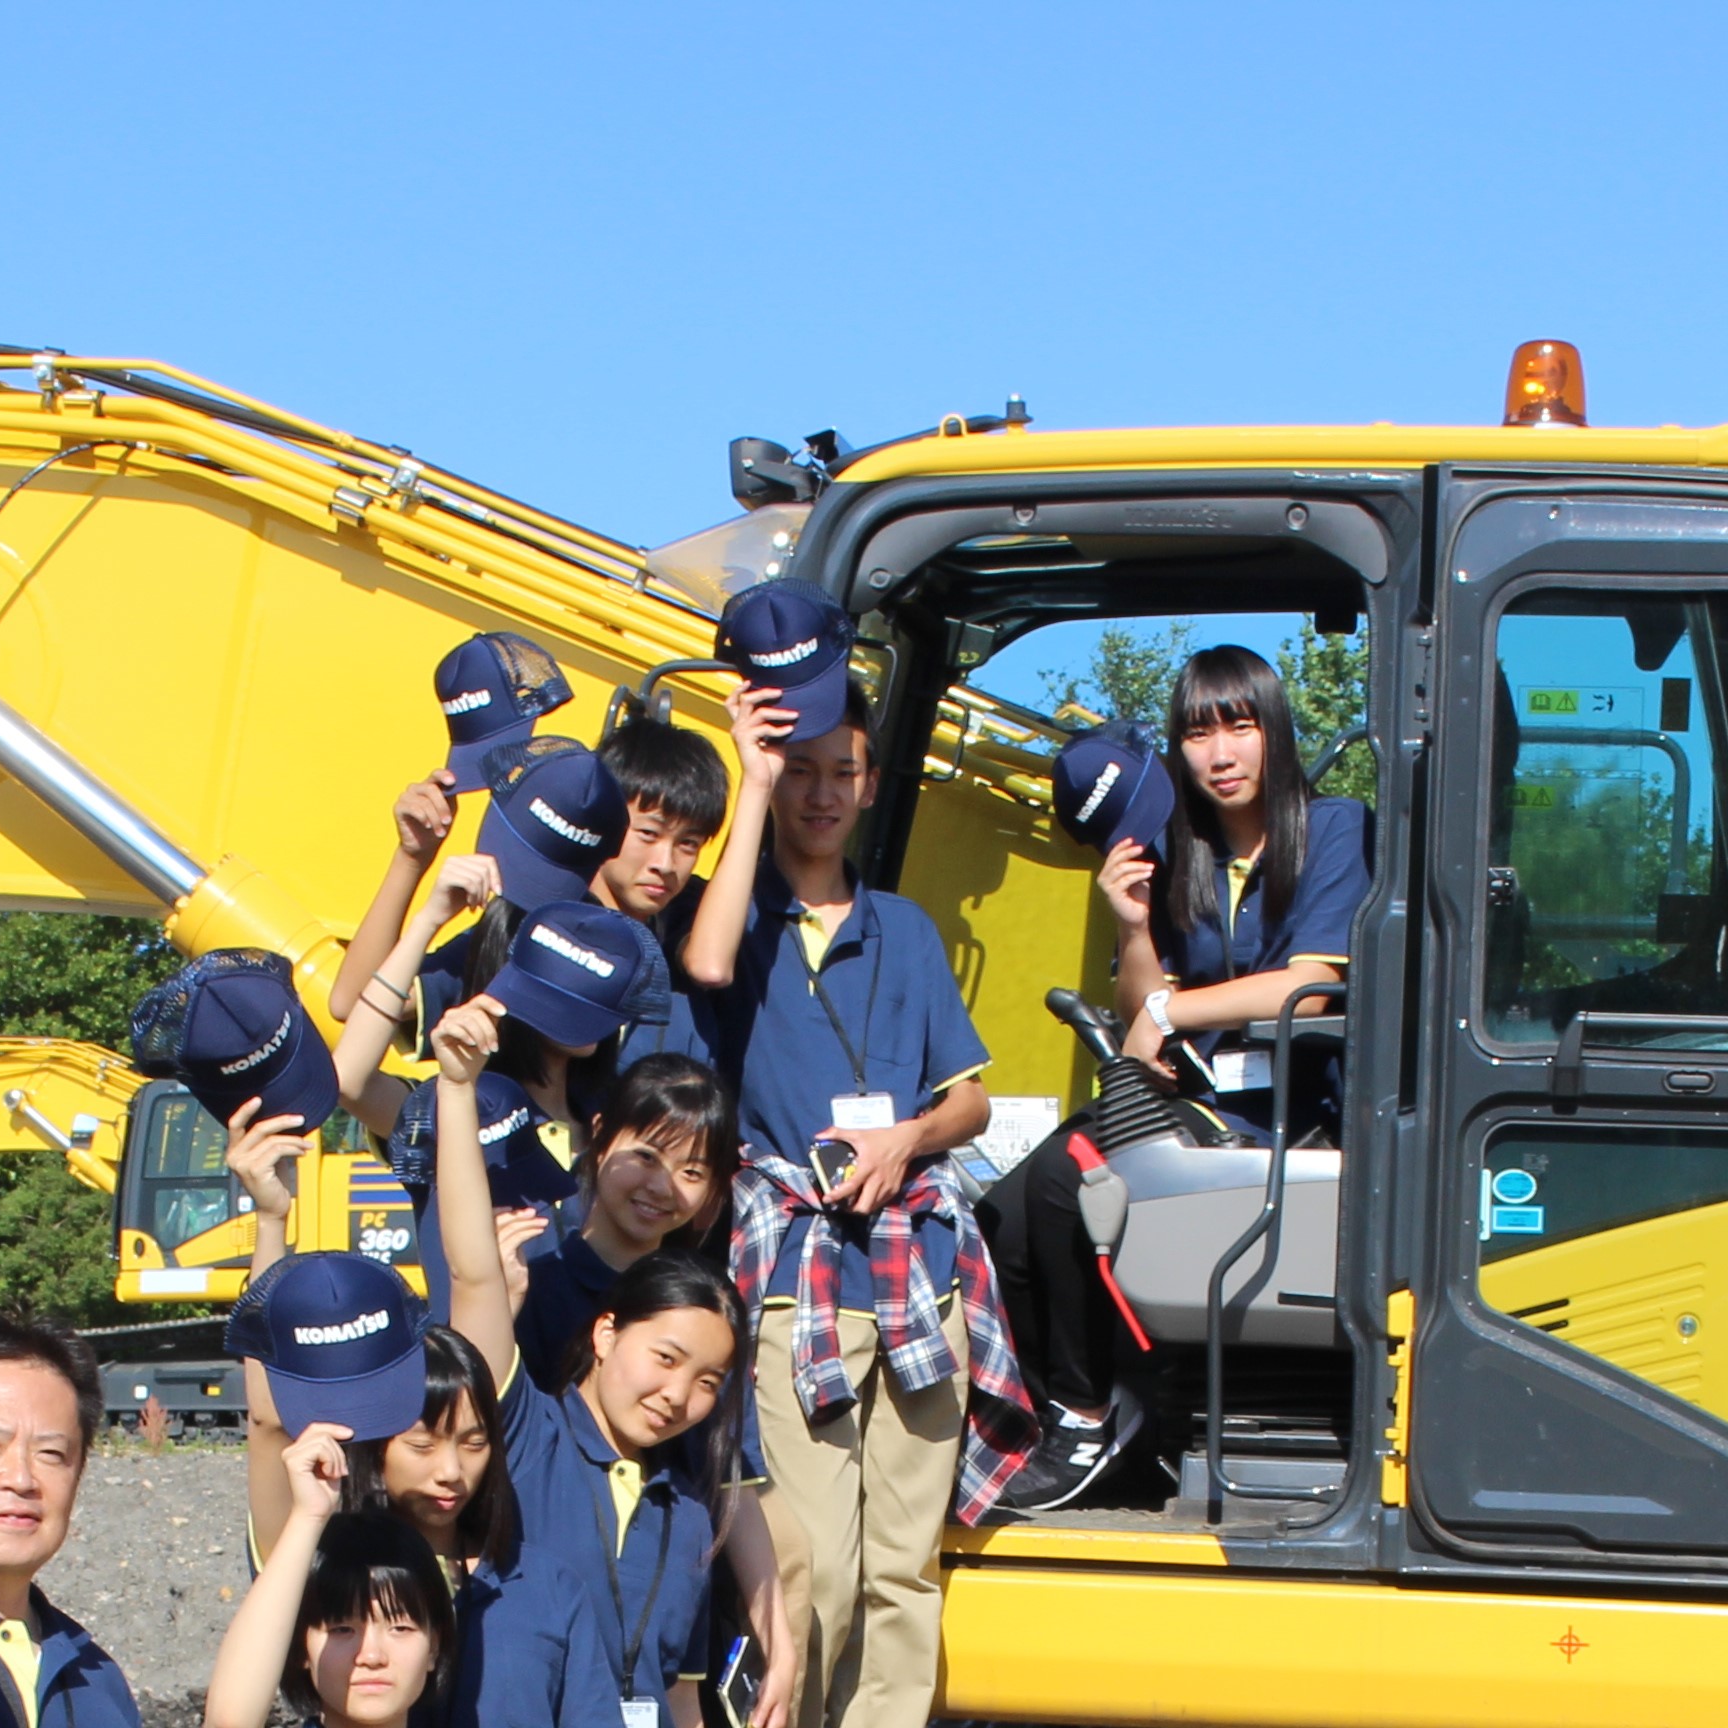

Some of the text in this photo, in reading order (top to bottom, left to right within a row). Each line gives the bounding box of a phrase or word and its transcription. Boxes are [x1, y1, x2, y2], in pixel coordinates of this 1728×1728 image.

[749, 637, 818, 667] KOMATSU
[442, 688, 492, 715] MATSU
[1075, 762, 1122, 823] KOMATSU
[529, 797, 603, 847] KOMATSU
[530, 923, 616, 978] KOMATSU
[220, 1010, 292, 1075] KOMATSU
[477, 1106, 530, 1145] OMATSU
[359, 1211, 387, 1228] PC
[358, 1228, 410, 1251] 360
[294, 1309, 390, 1345] KOMATSU
